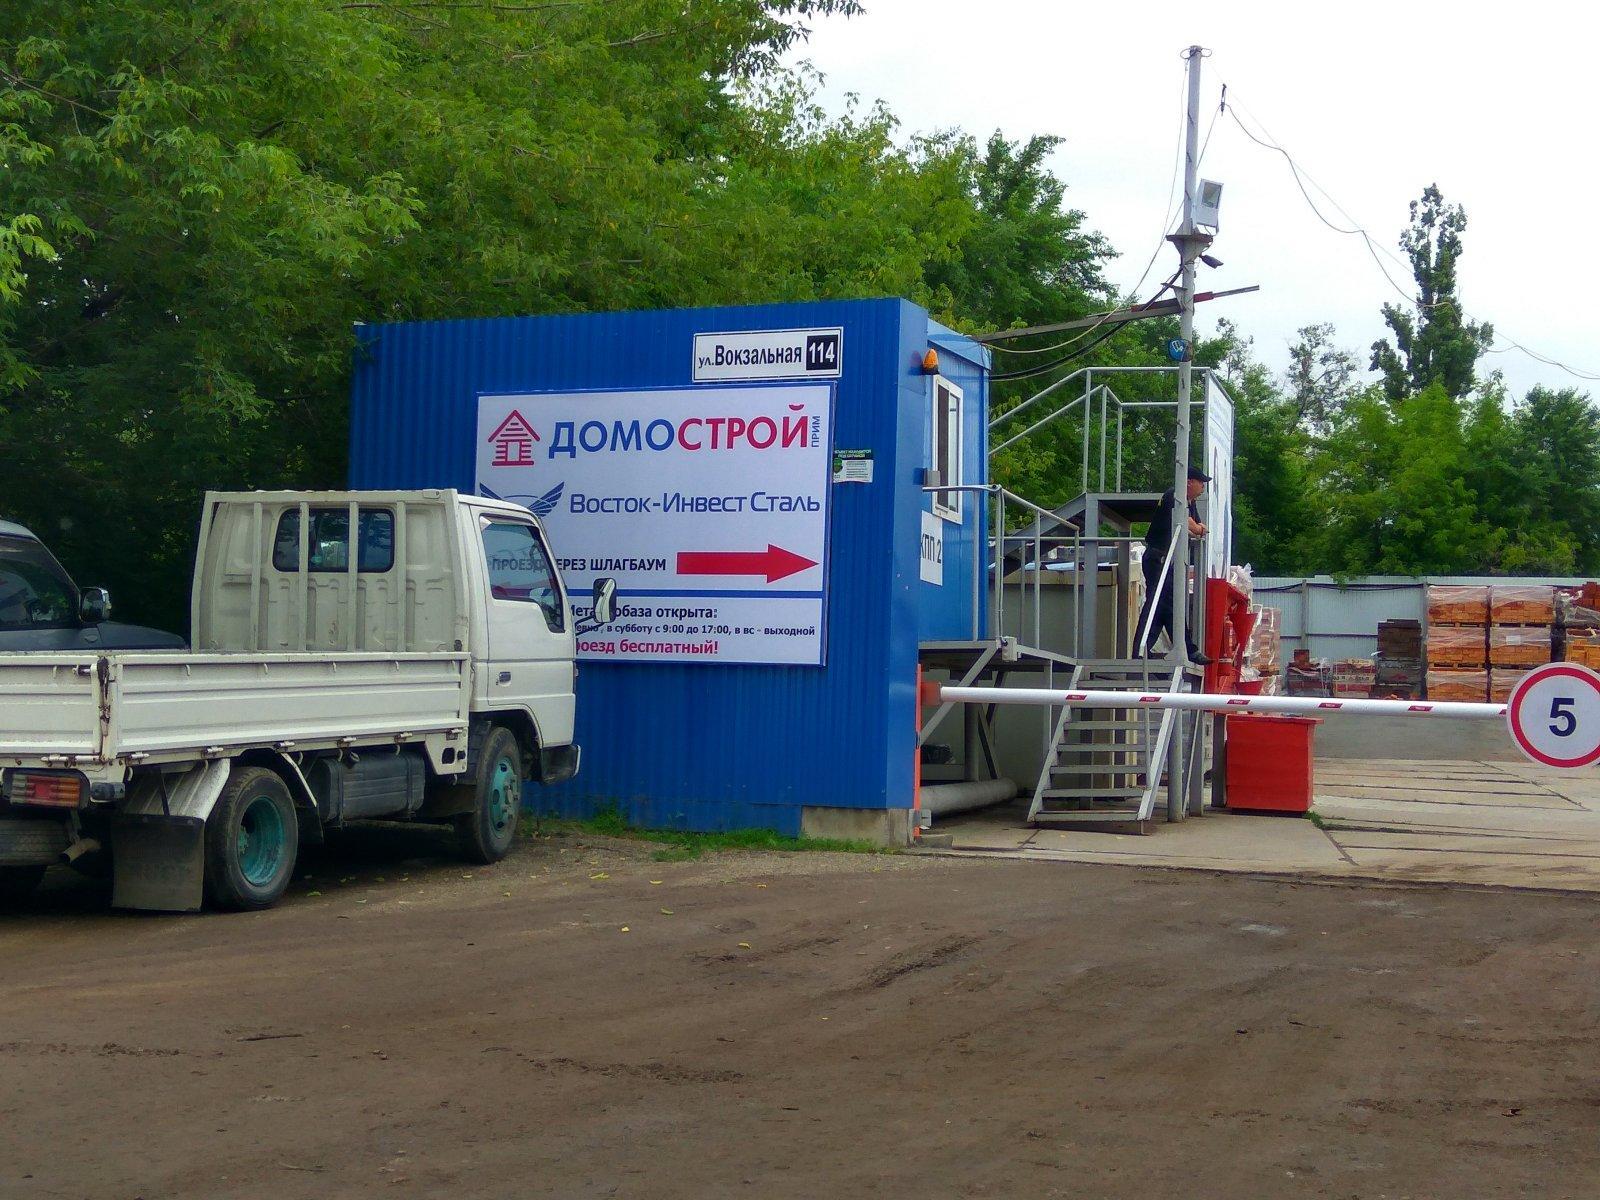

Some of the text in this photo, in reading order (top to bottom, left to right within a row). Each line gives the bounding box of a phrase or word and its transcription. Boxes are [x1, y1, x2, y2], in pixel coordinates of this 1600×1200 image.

[808, 341, 836, 364] 114
[548, 403, 809, 459] ДОМОСТРОЙ
[811, 415, 821, 448] ПРИМ
[750, 491, 821, 513] Сталь
[936, 538, 942, 564] 2
[555, 558, 587, 571] ЕРЕЗ
[590, 558, 667, 571] ШЛАГБАУМ
[570, 604, 718, 620] етаобаза открыта:
[614, 623, 653, 634] субботу
[662, 624, 684, 633] 9:00
[686, 626, 699, 634] до
[701, 625, 732, 635] 17:00,
[764, 626, 815, 636] выходной
[576, 638, 719, 655] оезд бесплатный!
[1548, 697, 1577, 738] 5
